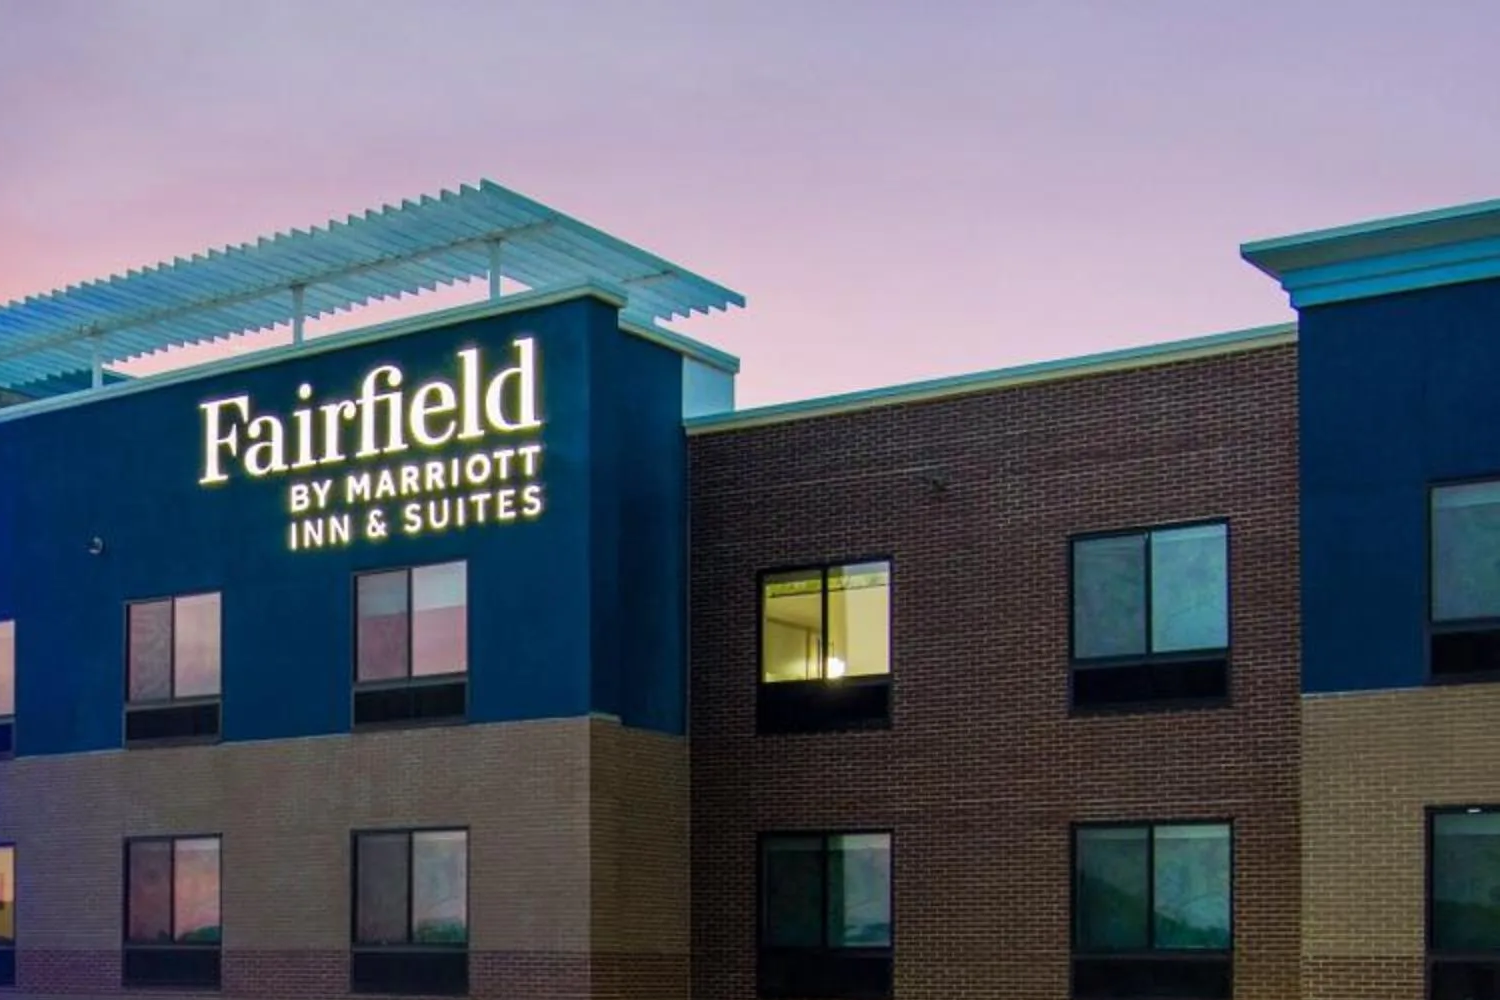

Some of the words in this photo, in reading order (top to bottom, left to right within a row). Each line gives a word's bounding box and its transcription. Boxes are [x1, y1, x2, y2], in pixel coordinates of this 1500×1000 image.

[199, 337, 542, 484] Fairfield
[291, 480, 332, 512] BY
[347, 445, 541, 503] MARRIOTT
[291, 515, 349, 550] INN
[366, 509, 387, 538] &
[404, 485, 542, 533] SUITES
